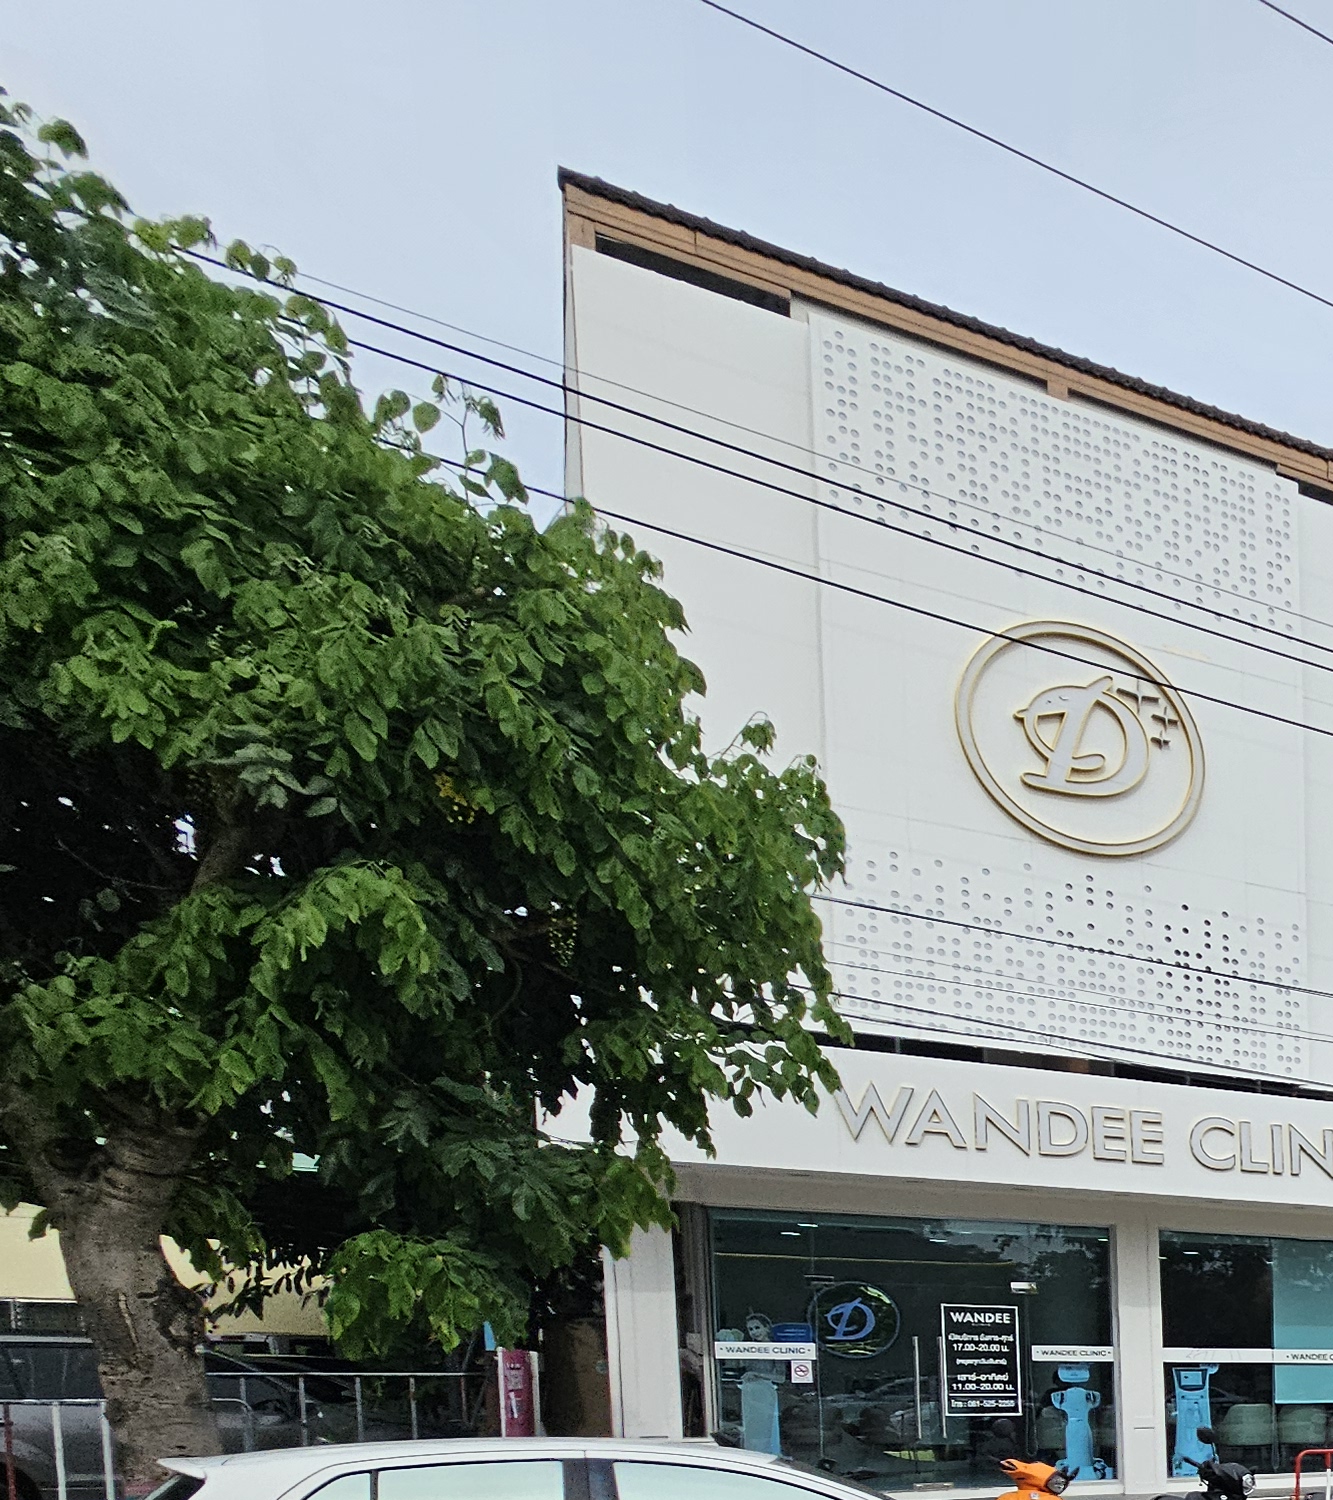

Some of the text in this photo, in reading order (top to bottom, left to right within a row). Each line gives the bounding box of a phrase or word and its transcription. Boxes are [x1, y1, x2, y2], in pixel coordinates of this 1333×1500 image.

[835, 1081, 1165, 1165] WANDEE
[949, 1311, 1011, 1324] WANDEE
[725, 1346, 806, 1354] WANDEE CLINIC
[1041, 1349, 1078, 1357] WANDEE
[951, 1383, 1004, 1391] 11.00-20.00
